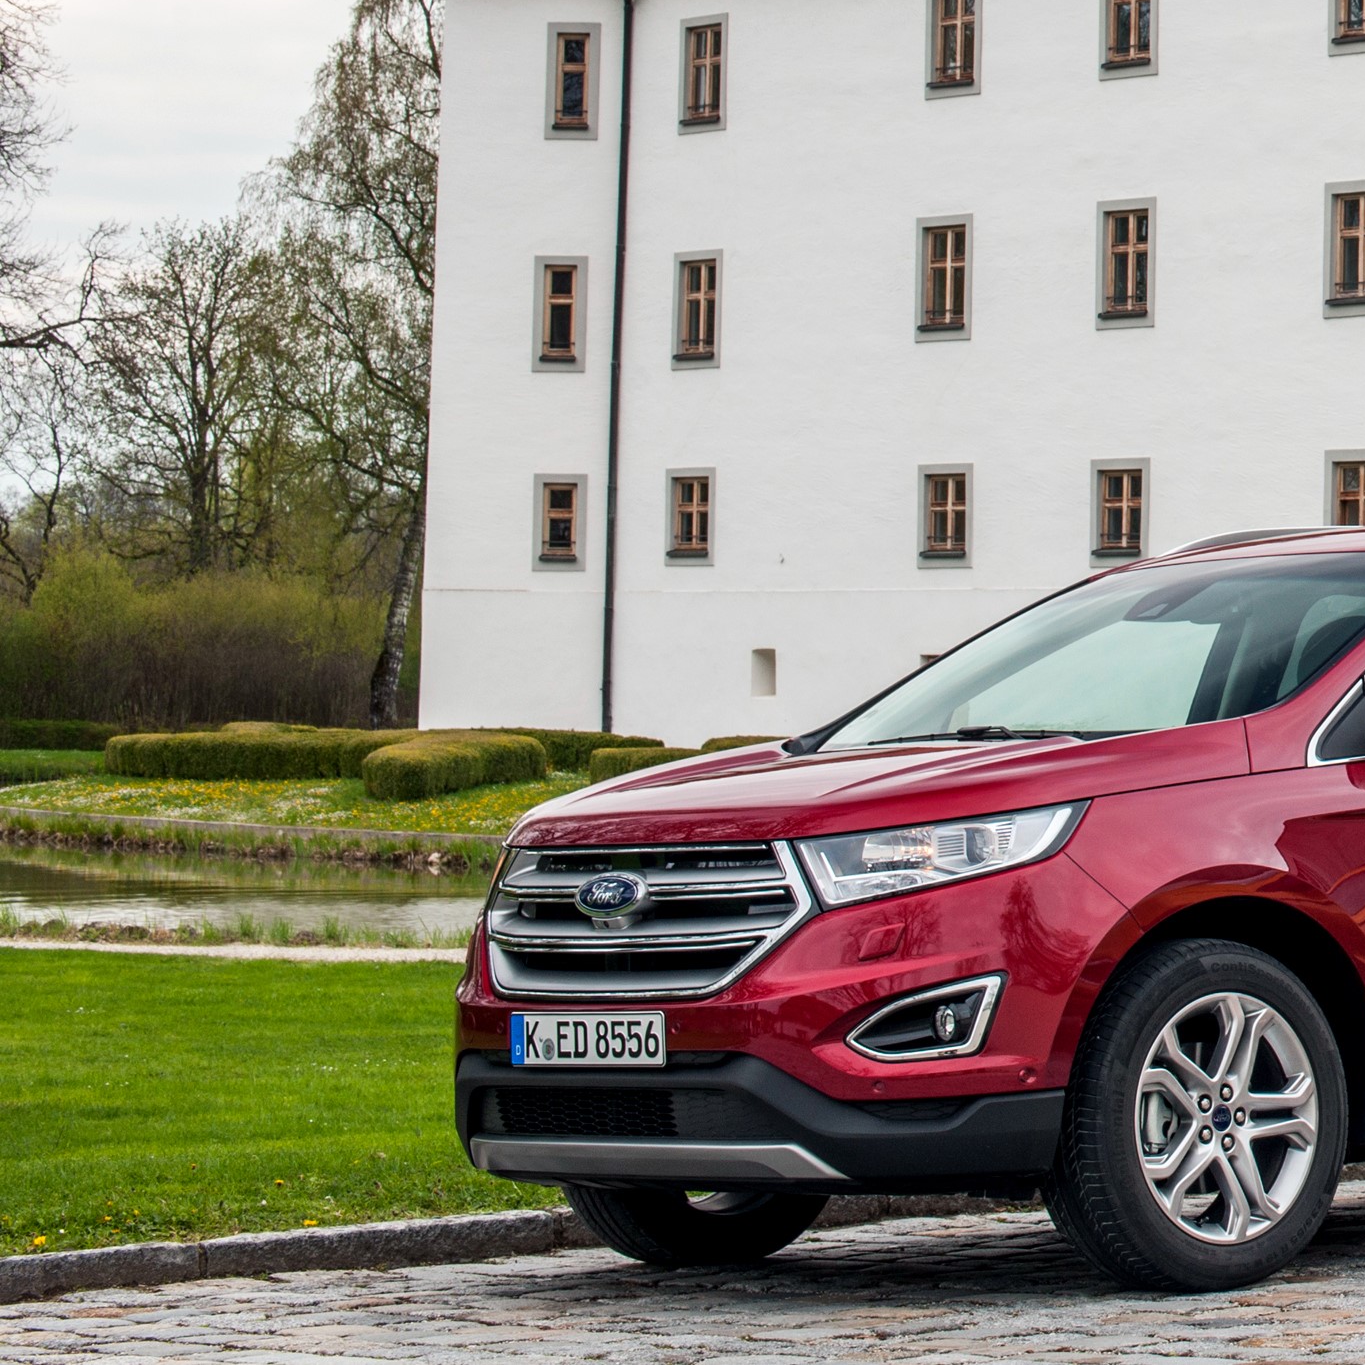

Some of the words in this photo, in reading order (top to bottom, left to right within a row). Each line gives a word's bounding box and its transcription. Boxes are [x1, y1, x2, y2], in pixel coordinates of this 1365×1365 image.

[587, 881, 625, 905] Ford
[515, 1044, 522, 1055] D
[525, 1020, 540, 1059] K
[556, 1020, 588, 1059] ED
[595, 1020, 660, 1059] 8556
